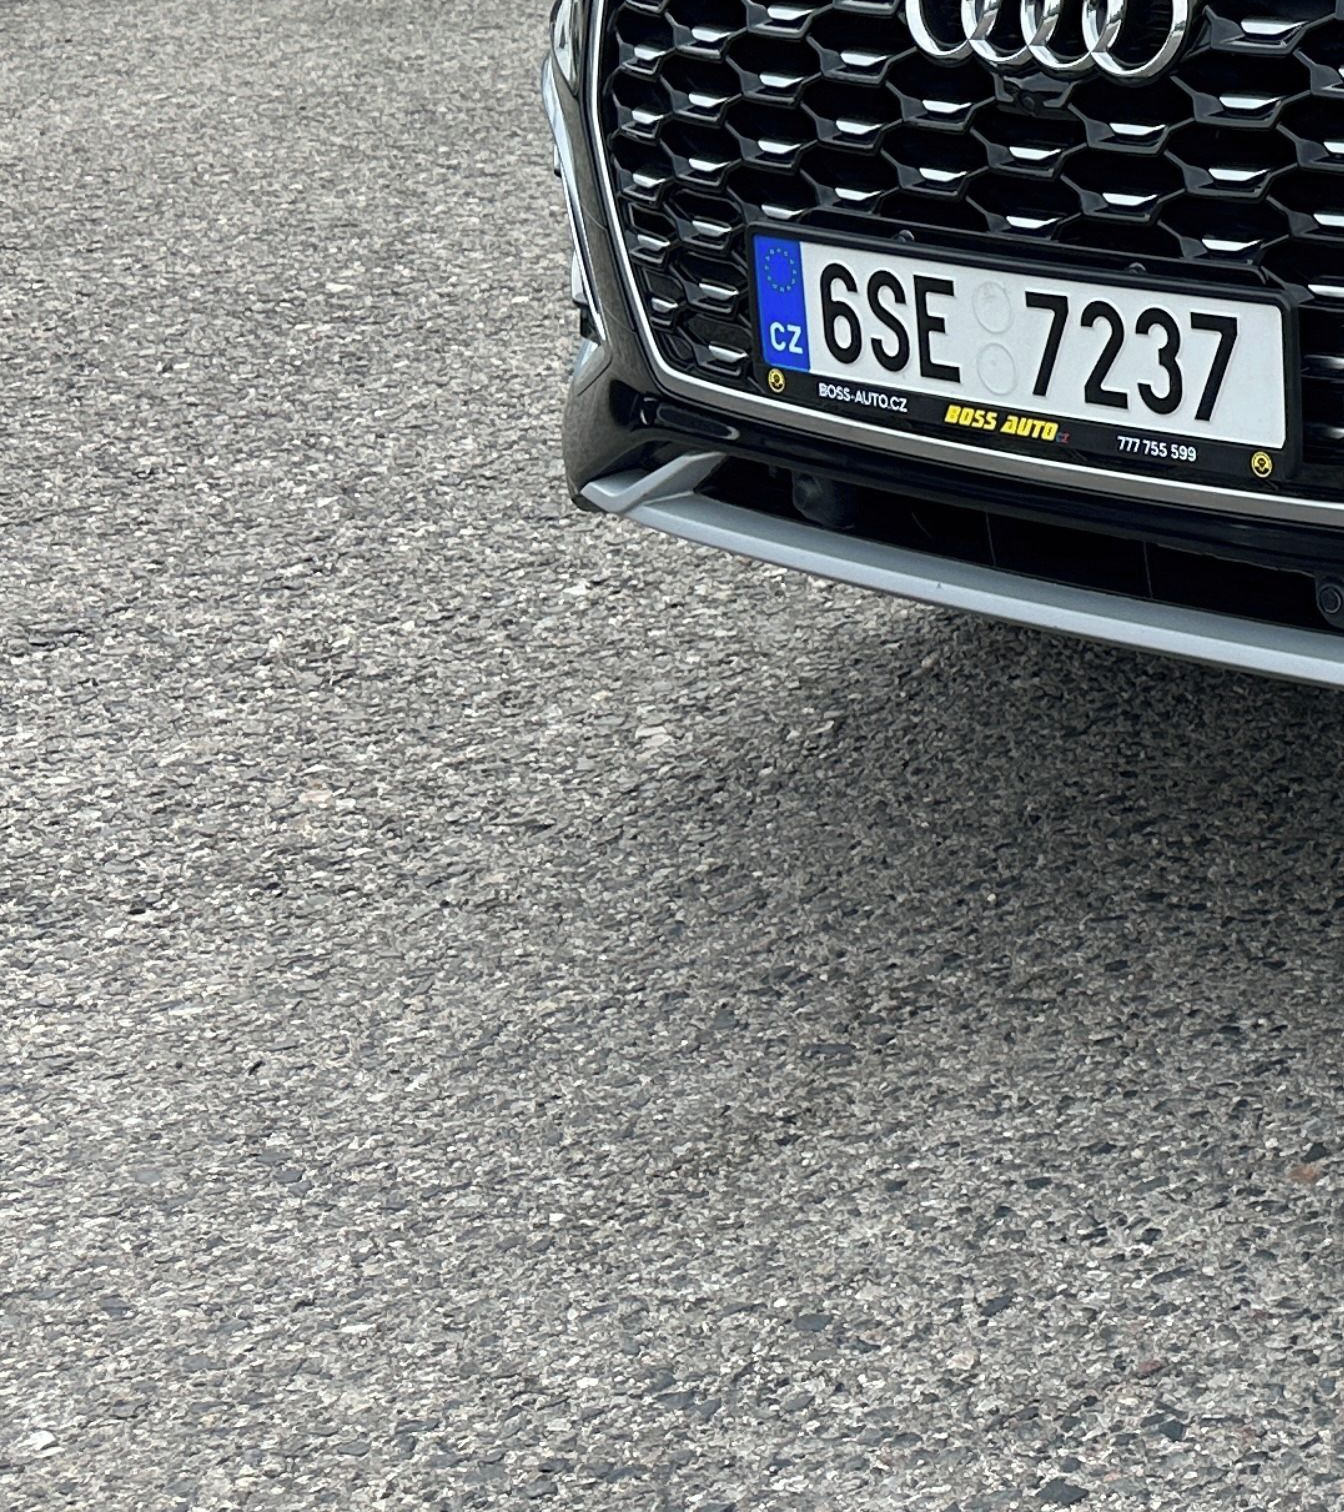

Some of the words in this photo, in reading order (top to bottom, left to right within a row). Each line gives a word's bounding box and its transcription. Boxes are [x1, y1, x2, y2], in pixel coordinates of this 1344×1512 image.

[768, 321, 804, 356] CZ
[818, 262, 962, 385] 6SE
[1024, 289, 1239, 422] 7237
[818, 382, 908, 414] BOSS-AUTO.CZ
[943, 404, 998, 431] BOSS
[1000, 414, 1060, 442] AUTO
[1116, 435, 1143, 454] 777
[1143, 438, 1168, 459] 755
[1171, 440, 1197, 462] 599
